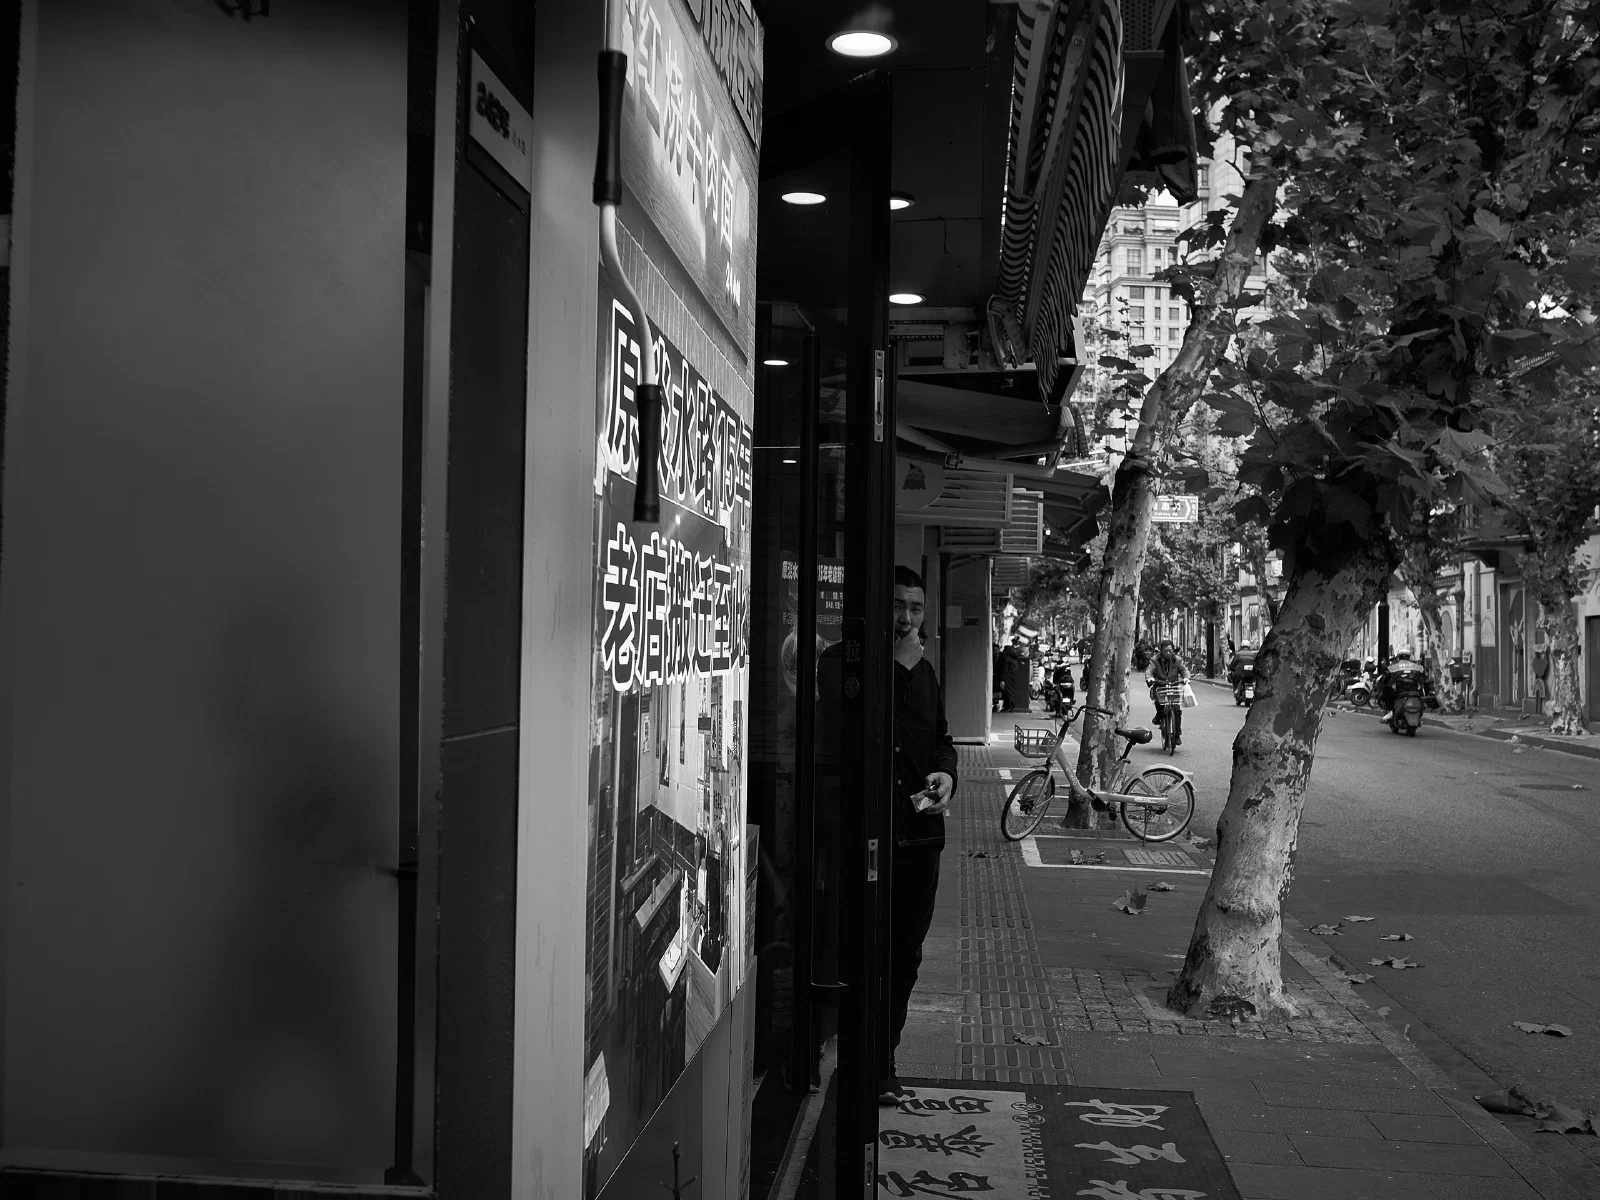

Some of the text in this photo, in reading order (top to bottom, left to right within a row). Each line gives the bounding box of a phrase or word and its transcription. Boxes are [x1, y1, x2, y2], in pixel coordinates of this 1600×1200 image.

[637, 0, 734, 254] 红烧牛肉面
[602, 522, 748, 692] 老店搬迁至此
[845, 639, 861, 664] 拉
[1019, 1122, 1048, 1180] EVERYDAY
